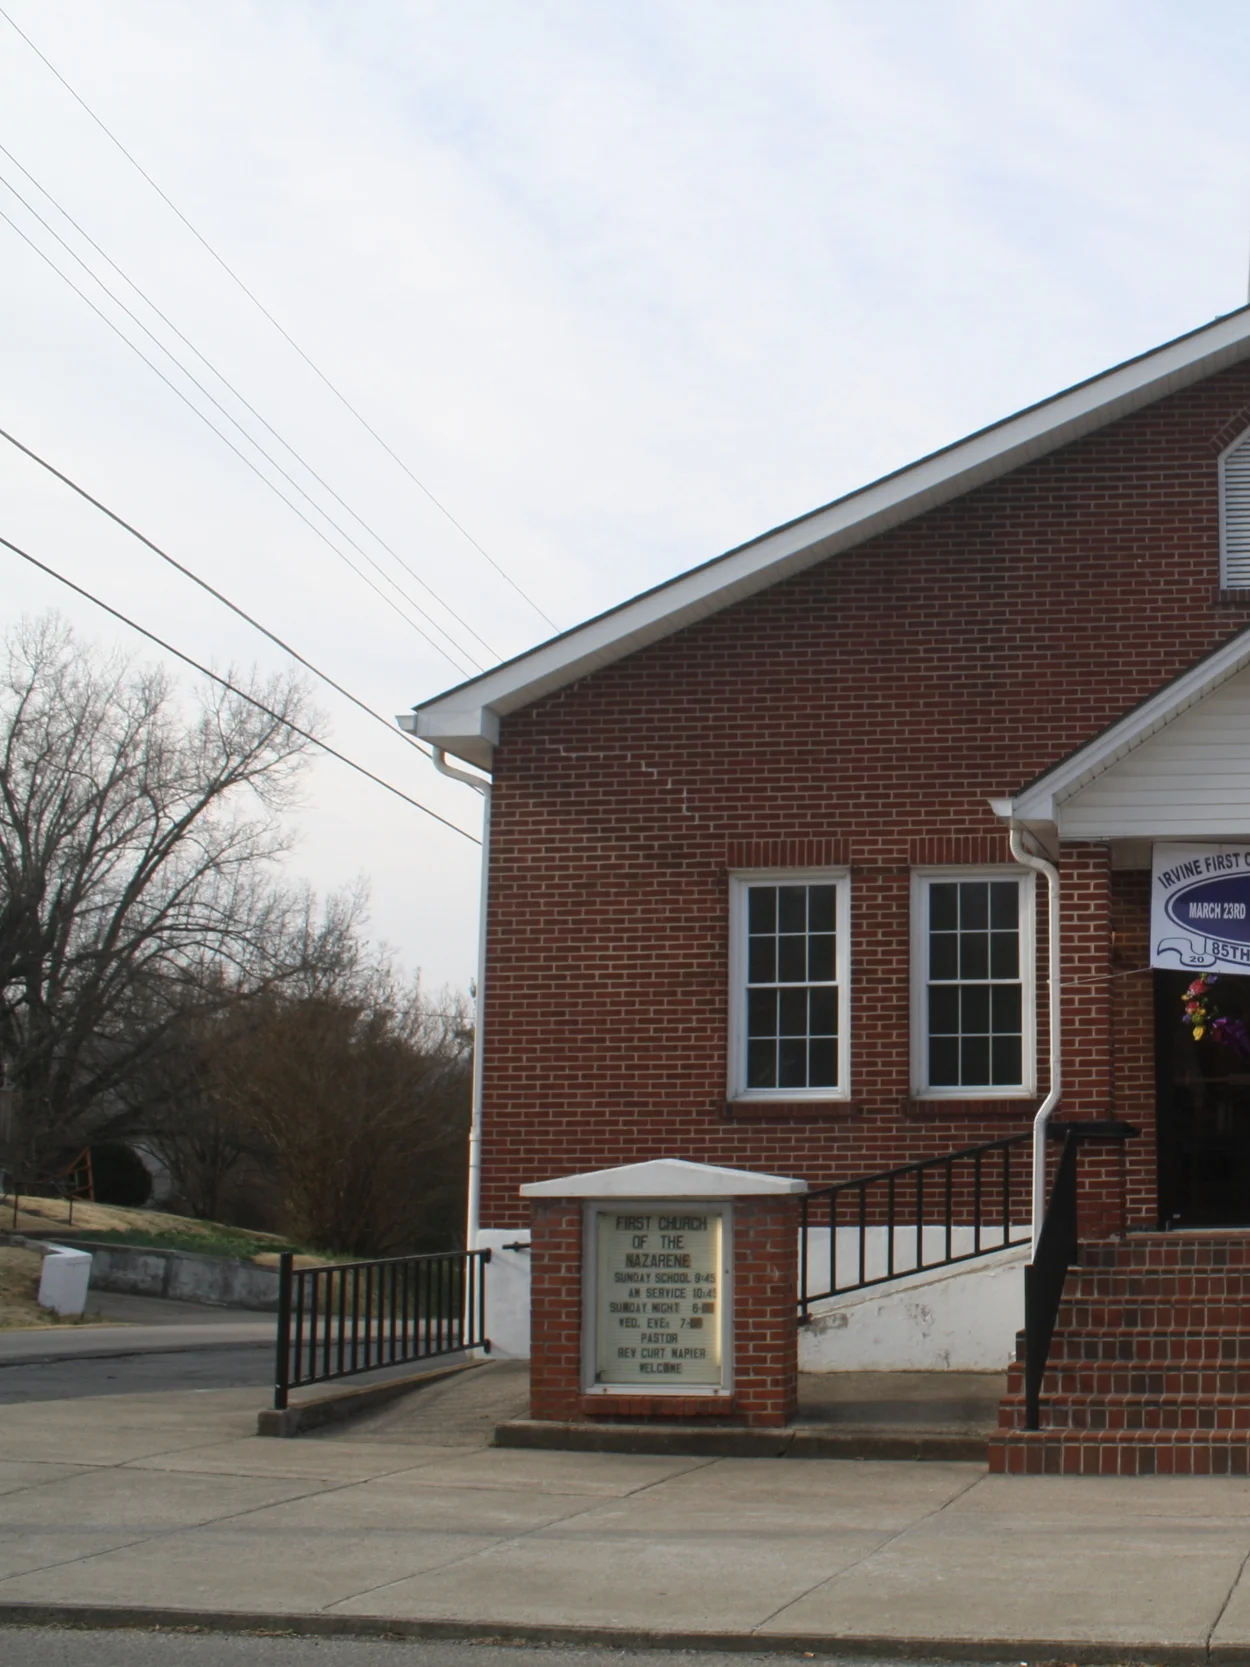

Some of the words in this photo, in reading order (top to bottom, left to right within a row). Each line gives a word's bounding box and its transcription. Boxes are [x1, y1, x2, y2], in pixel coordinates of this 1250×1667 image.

[1157, 859, 1203, 889] IRVINE
[1204, 853, 1240, 873] FIRST
[1189, 902, 1221, 919] MARCH
[1223, 903, 1246, 919] 23RD
[1212, 941, 1250, 962] 85TH
[1189, 955, 1205, 963] 20
[615, 1216, 651, 1231] FIRST
[658, 1216, 707, 1231] CHURCH
[632, 1235, 648, 1249] OF
[661, 1235, 684, 1249] THE
[626, 1253, 691, 1268] NAZARENE
[614, 1272, 651, 1284] SUNDAY
[655, 1272, 690, 1283] SCHOOL
[629, 1288, 641, 1298] AM
[646, 1288, 686, 1298] SERVICE
[610, 1302, 647, 1313] SUNDAY
[651, 1302, 679, 1313] NIGHT
[641, 1333, 678, 1344] PASTOR
[641, 1348, 665, 1358] CURT
[639, 1362, 682, 1373] WELCOME
